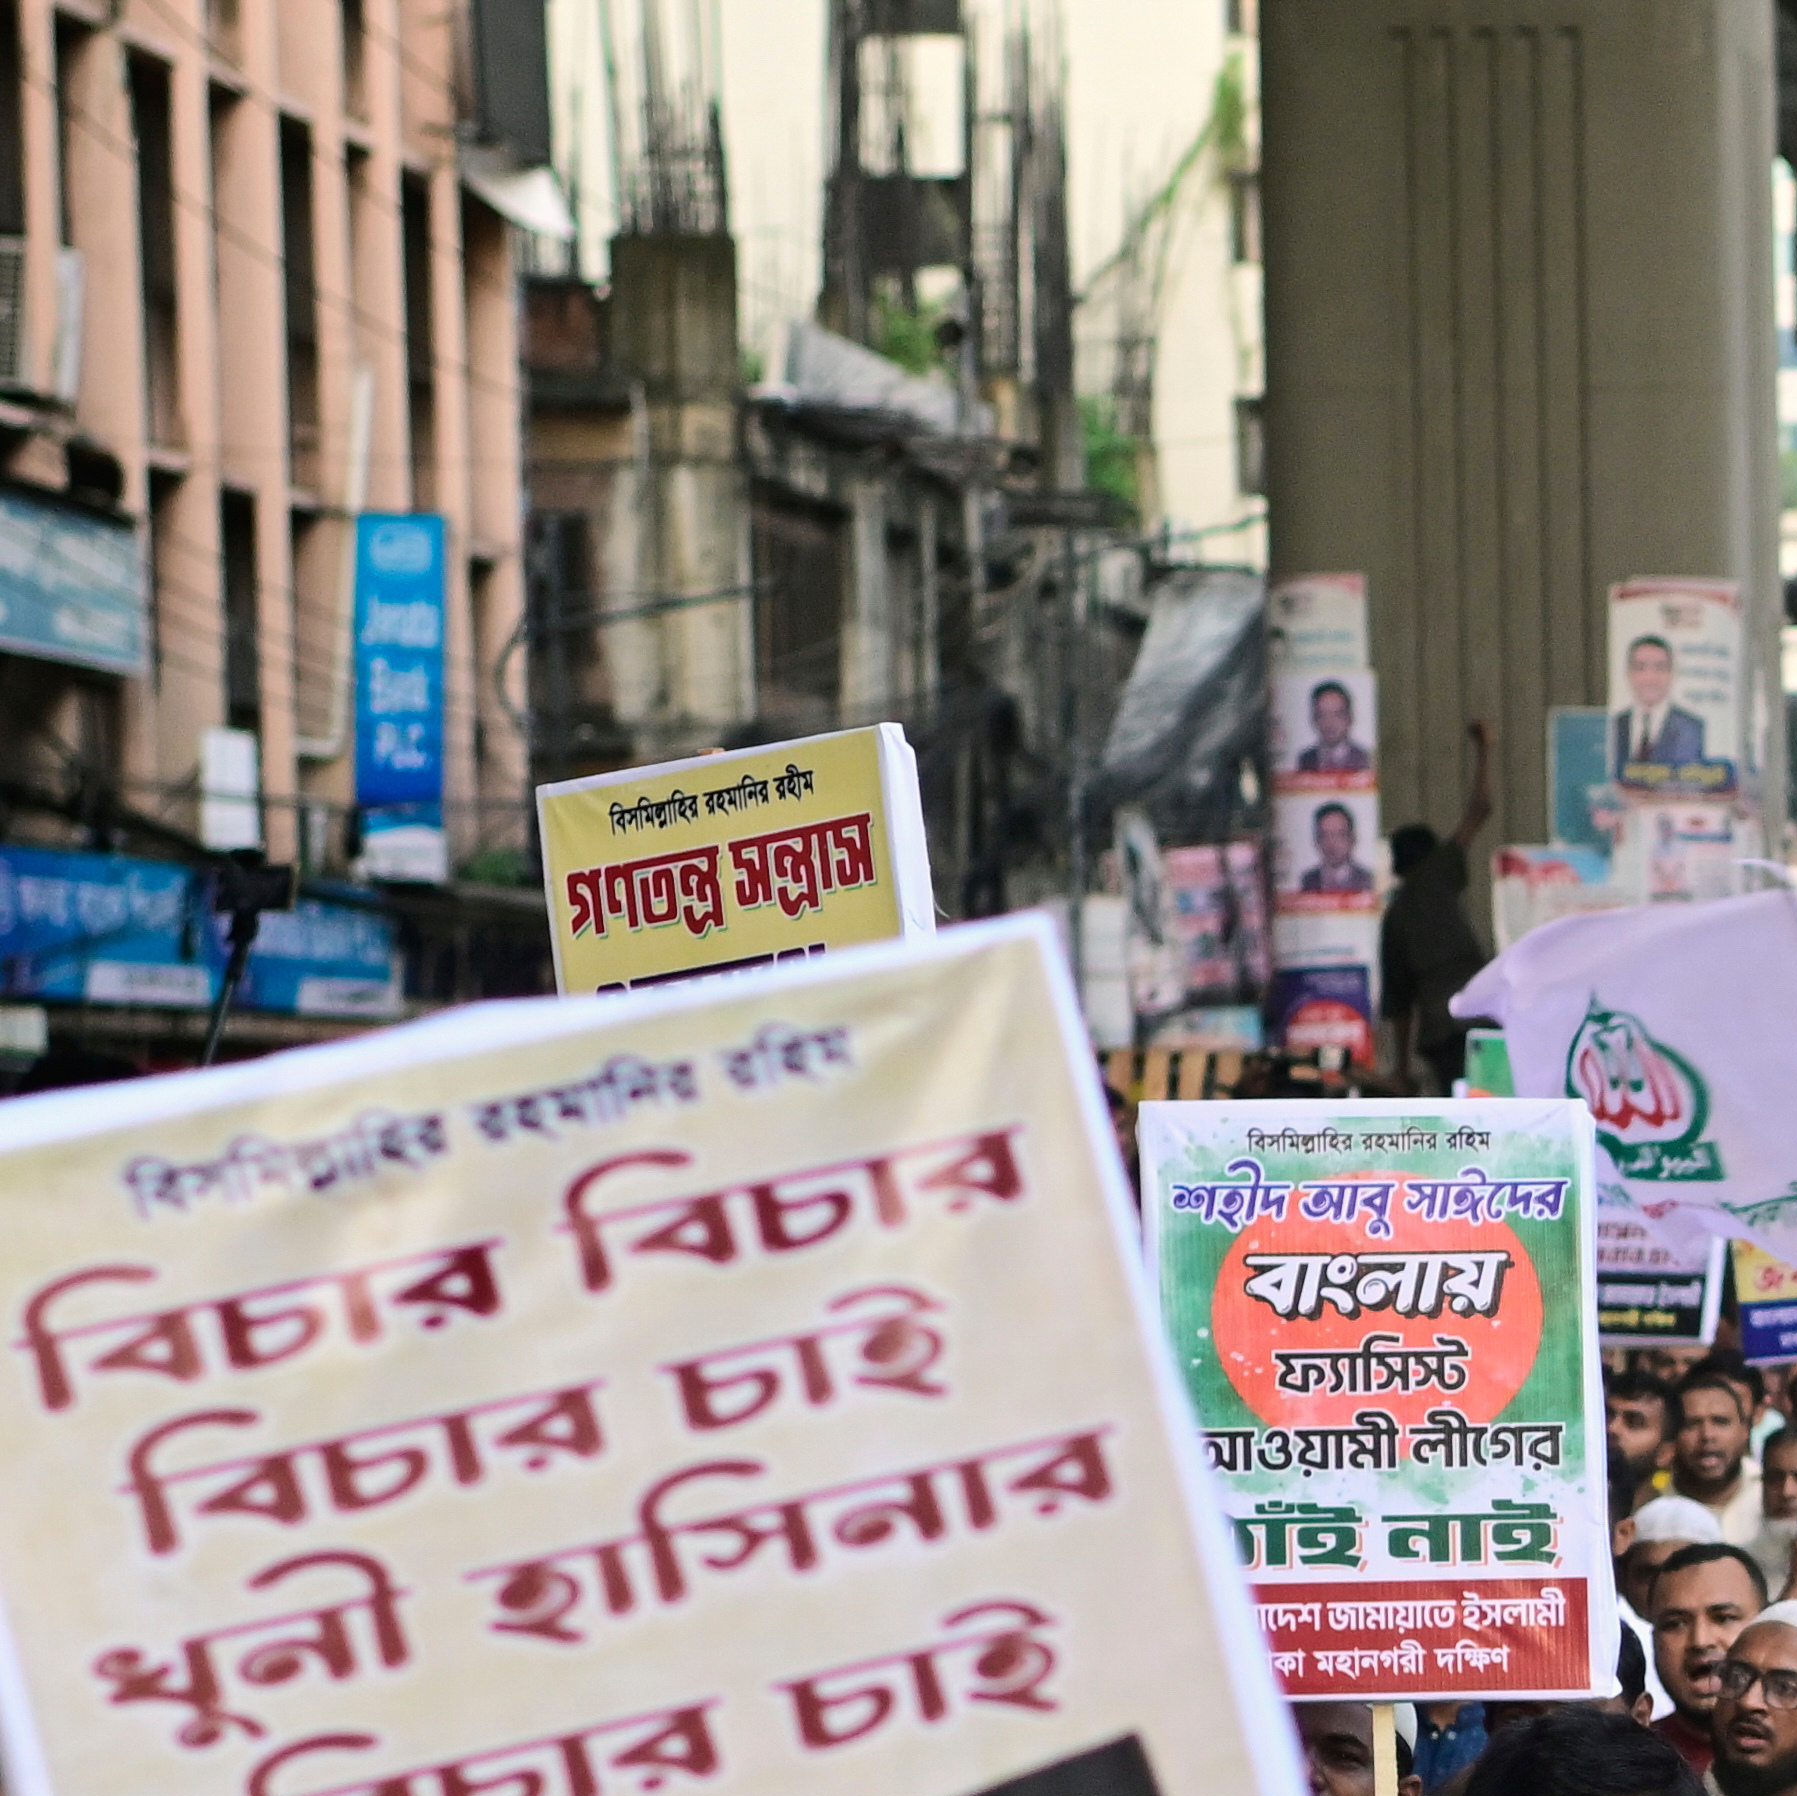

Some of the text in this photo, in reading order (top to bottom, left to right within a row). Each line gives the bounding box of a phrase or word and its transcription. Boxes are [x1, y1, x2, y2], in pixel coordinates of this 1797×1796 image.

[610, 790, 699, 836] বিসমিল্লাহির
[703, 774, 769, 816] রহমানির
[566, 812, 877, 938] গণতন্ত্র সন্ত্রাস
[471, 1055, 698, 1148] রহমানির
[720, 1020, 859, 1092] রহিম
[1246, 1128, 1491, 1154] বিসমিল্লাহির রহমানির রহিম
[1171, 1159, 1569, 1237] শহীদ আবু সাঈদের
[14, 1123, 1027, 1414] বিচার বিচার
[1243, 1250, 1514, 1321] বাংলায়
[1274, 1333, 1470, 1395] ফ্যাসিস্ট
[117, 1282, 949, 1556] বিচার চাই
[1202, 1409, 1565, 1478] আওয়ামী লীগের
[1382, 1499, 1564, 1569] নাই
[92, 1423, 1118, 1748] খুনী হাসিনার
[1327, 1600, 1456, 1634] জামায়াতে
[1462, 1587, 1566, 1631] ইসলামী
[771, 1599, 1061, 1753] চাই
[1313, 1639, 1426, 1680] মহানগরী
[1434, 1639, 1511, 1674] দক্ষিণ
